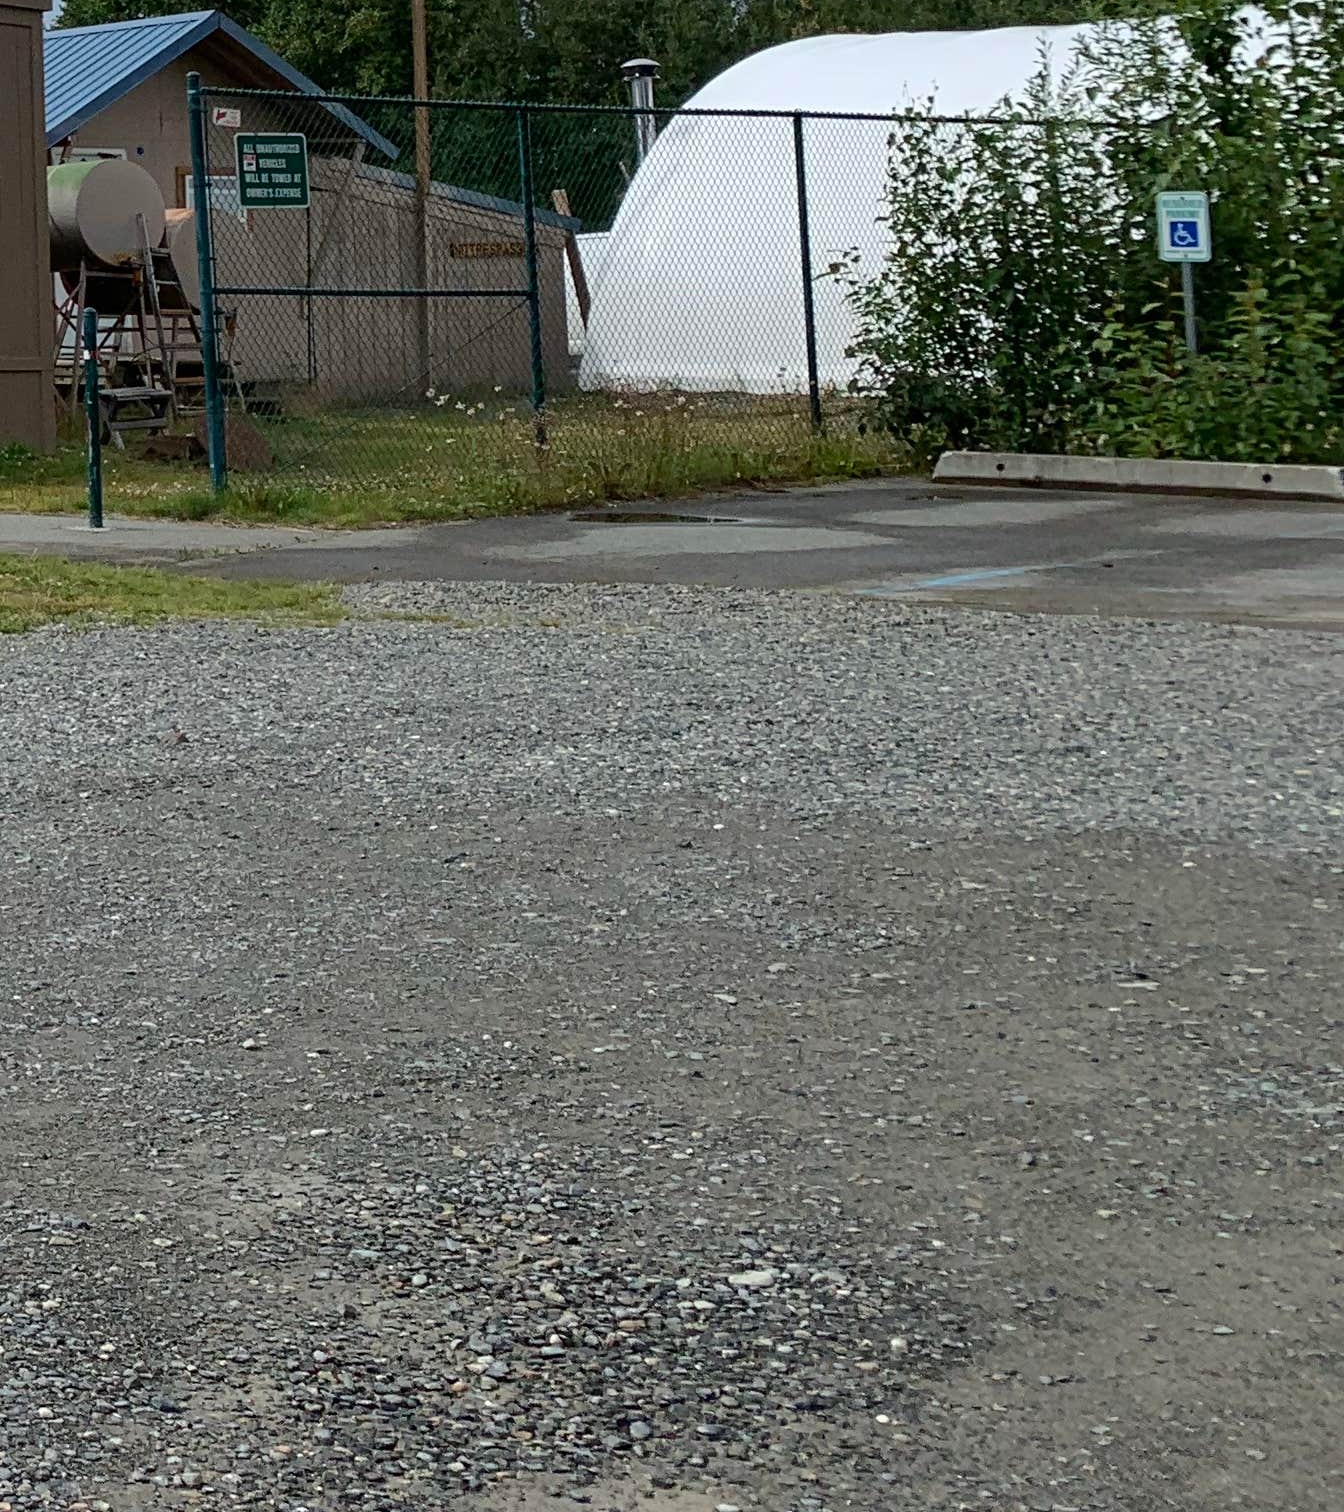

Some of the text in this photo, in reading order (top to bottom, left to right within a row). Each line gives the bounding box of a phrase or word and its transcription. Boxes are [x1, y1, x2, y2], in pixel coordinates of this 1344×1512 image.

[243, 143, 255, 153] ALL
[259, 158, 286, 169] VEHICLES
[244, 173, 260, 183] WILL
[271, 173, 292, 183] TOWED
[293, 173, 302, 184] AT
[246, 187, 302, 198] OWNER'S EXPENSE
